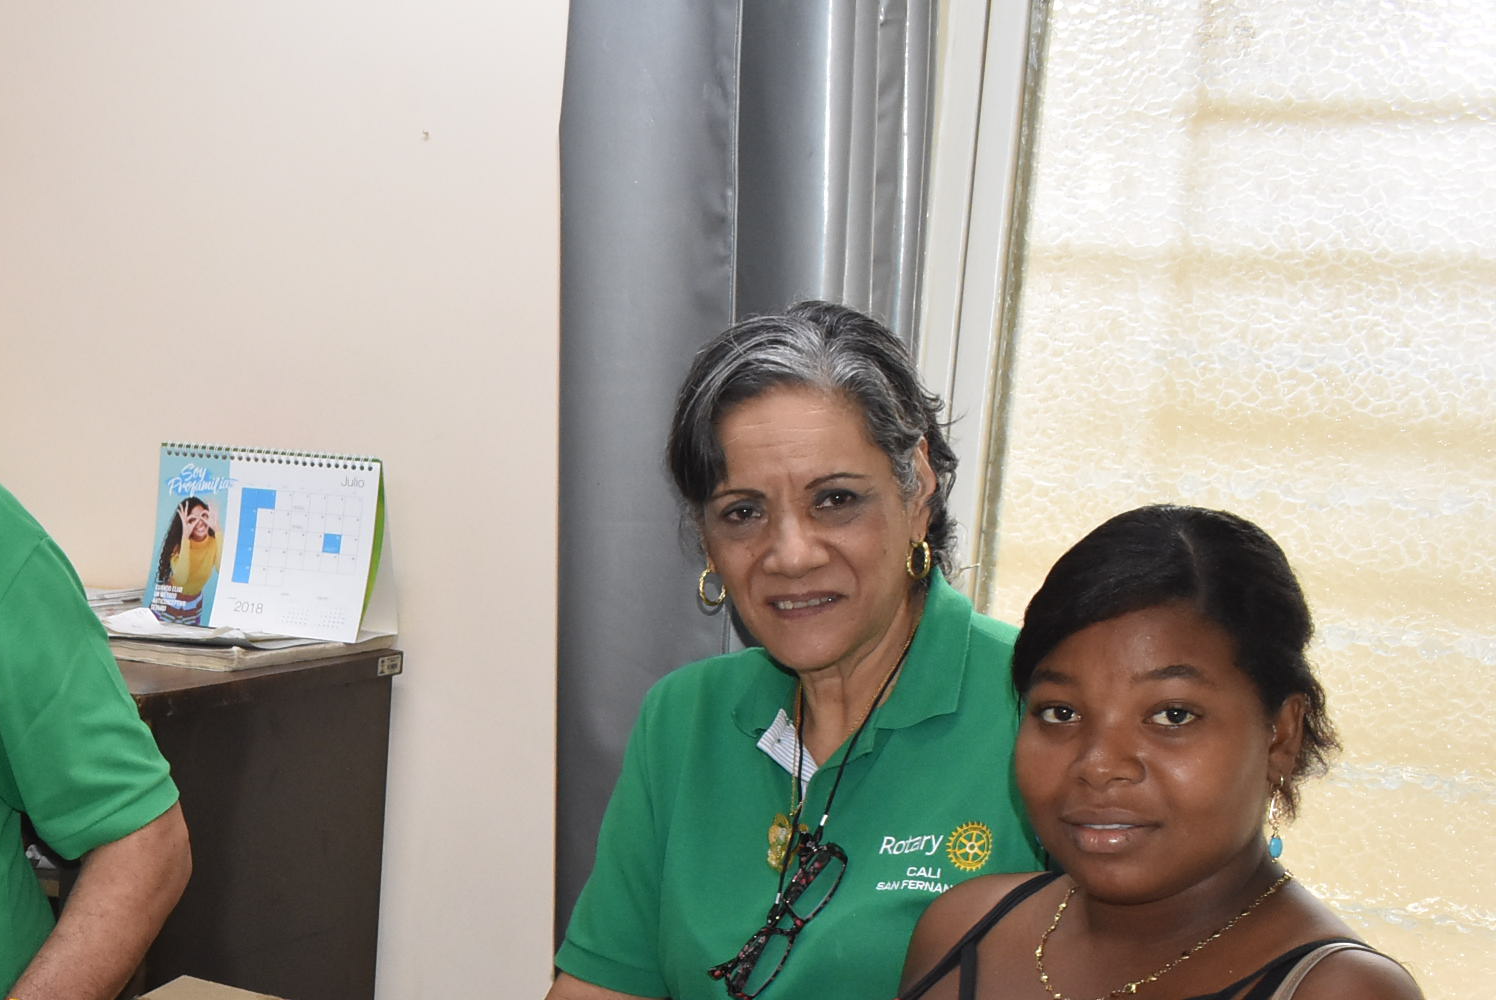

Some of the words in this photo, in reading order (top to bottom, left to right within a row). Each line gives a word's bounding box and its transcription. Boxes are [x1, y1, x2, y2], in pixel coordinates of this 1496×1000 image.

[340, 474, 365, 489] Julio
[233, 600, 264, 614] 2018
[878, 834, 944, 856] Rotary
[906, 866, 941, 879] CALI
[875, 881, 900, 891] SAN
